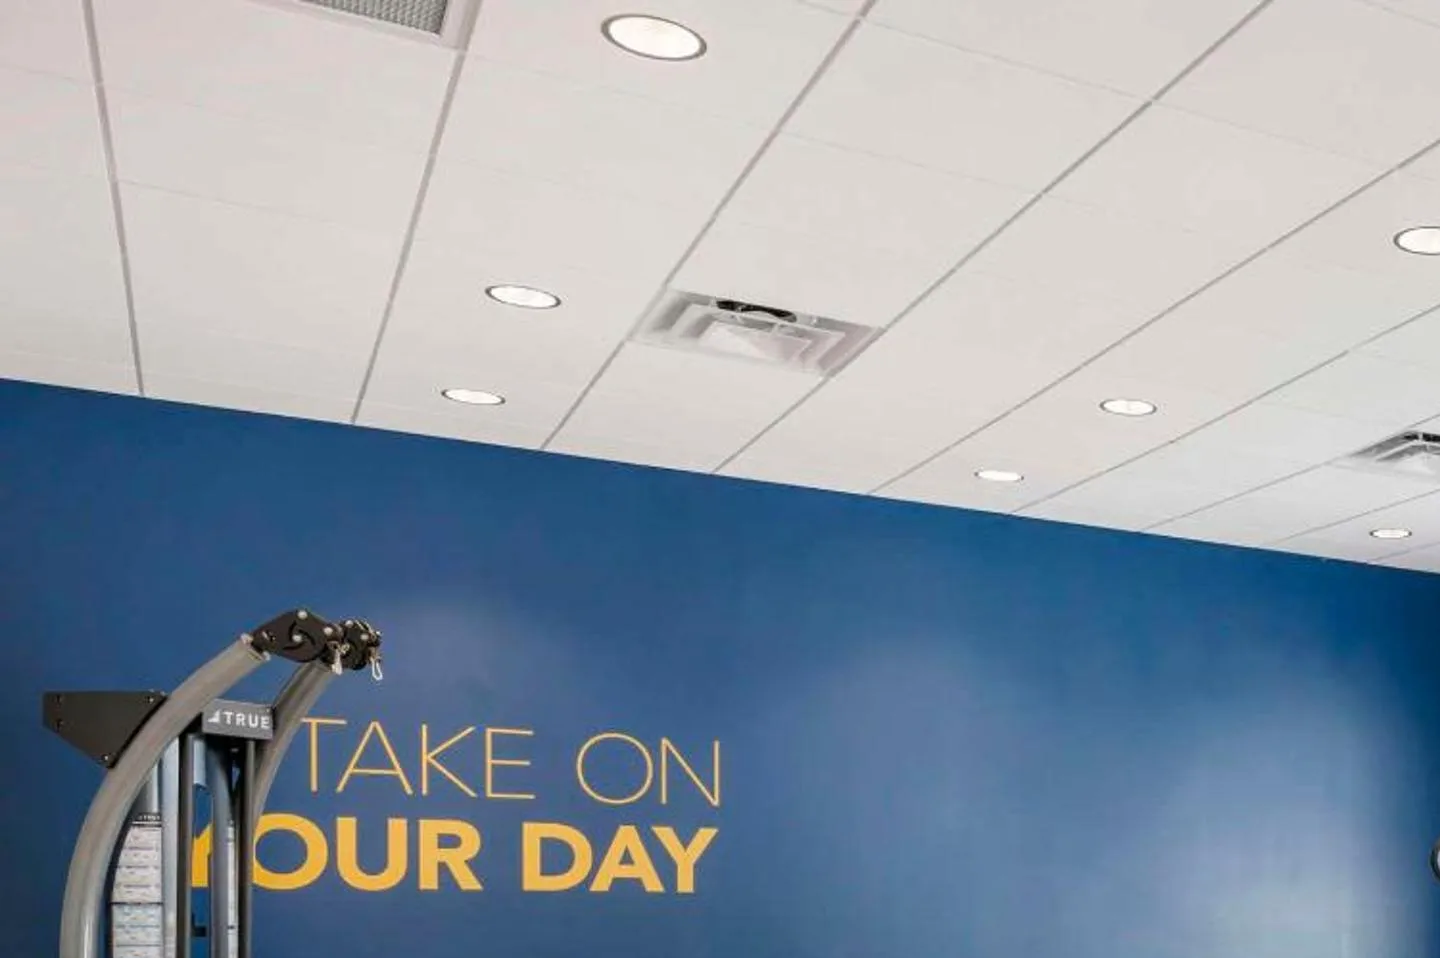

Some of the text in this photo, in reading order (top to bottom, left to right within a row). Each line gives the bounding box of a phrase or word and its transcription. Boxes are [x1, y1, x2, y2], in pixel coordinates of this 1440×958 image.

[223, 711, 270, 730] TRUE
[301, 716, 720, 806] TAKE ON
[522, 821, 718, 893] DAY
